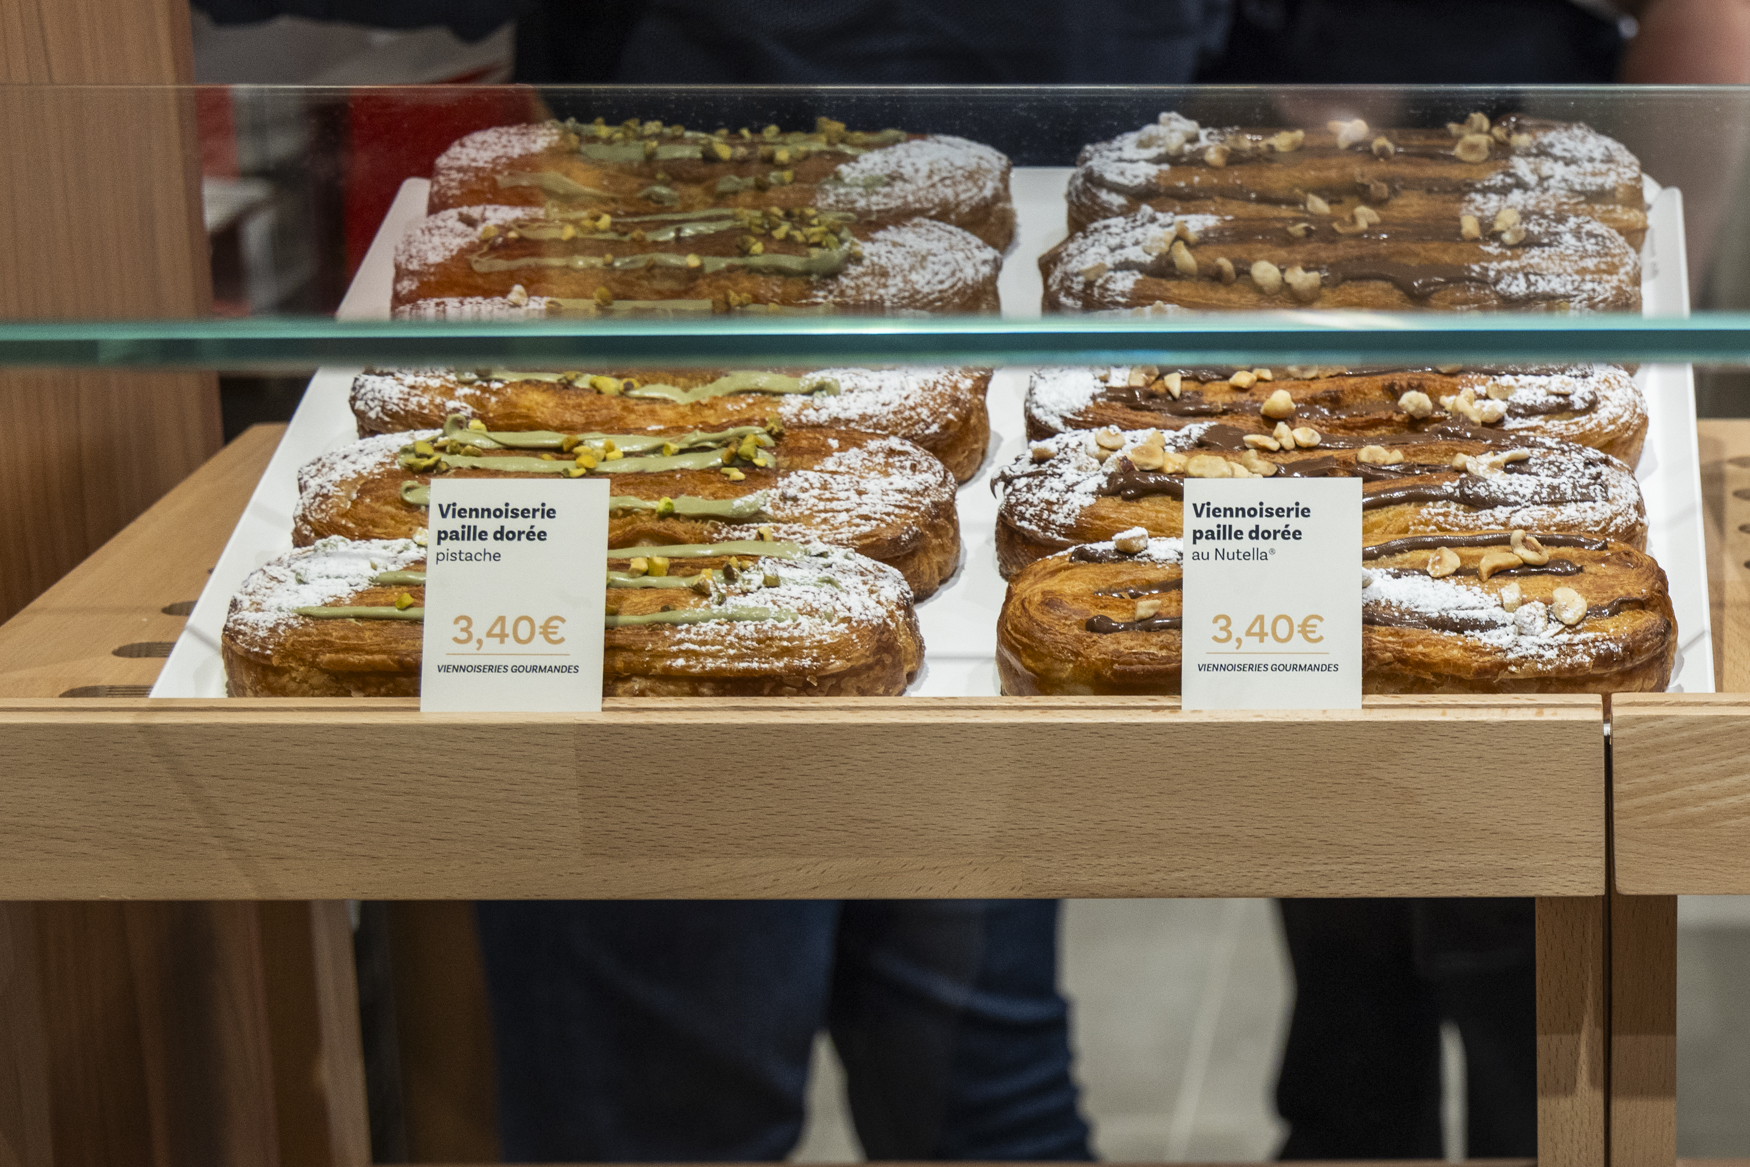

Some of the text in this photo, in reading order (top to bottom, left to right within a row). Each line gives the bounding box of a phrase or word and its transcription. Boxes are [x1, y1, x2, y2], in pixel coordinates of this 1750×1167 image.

[438, 502, 557, 519] Viennoiserie
[1192, 502, 1311, 519] Viennoiserie
[436, 525, 548, 545] paille dorée
[1192, 524, 1303, 545] paille dorée
[435, 548, 502, 565] pistache
[1191, 551, 1210, 561] au
[451, 615, 567, 651] 3,40€
[1211, 614, 1325, 650] 3,40€
[437, 664, 580, 674] VIENNOISERIES GOURMANDES
[1197, 663, 1339, 672] VIENNOISERIES GOURMANDES
